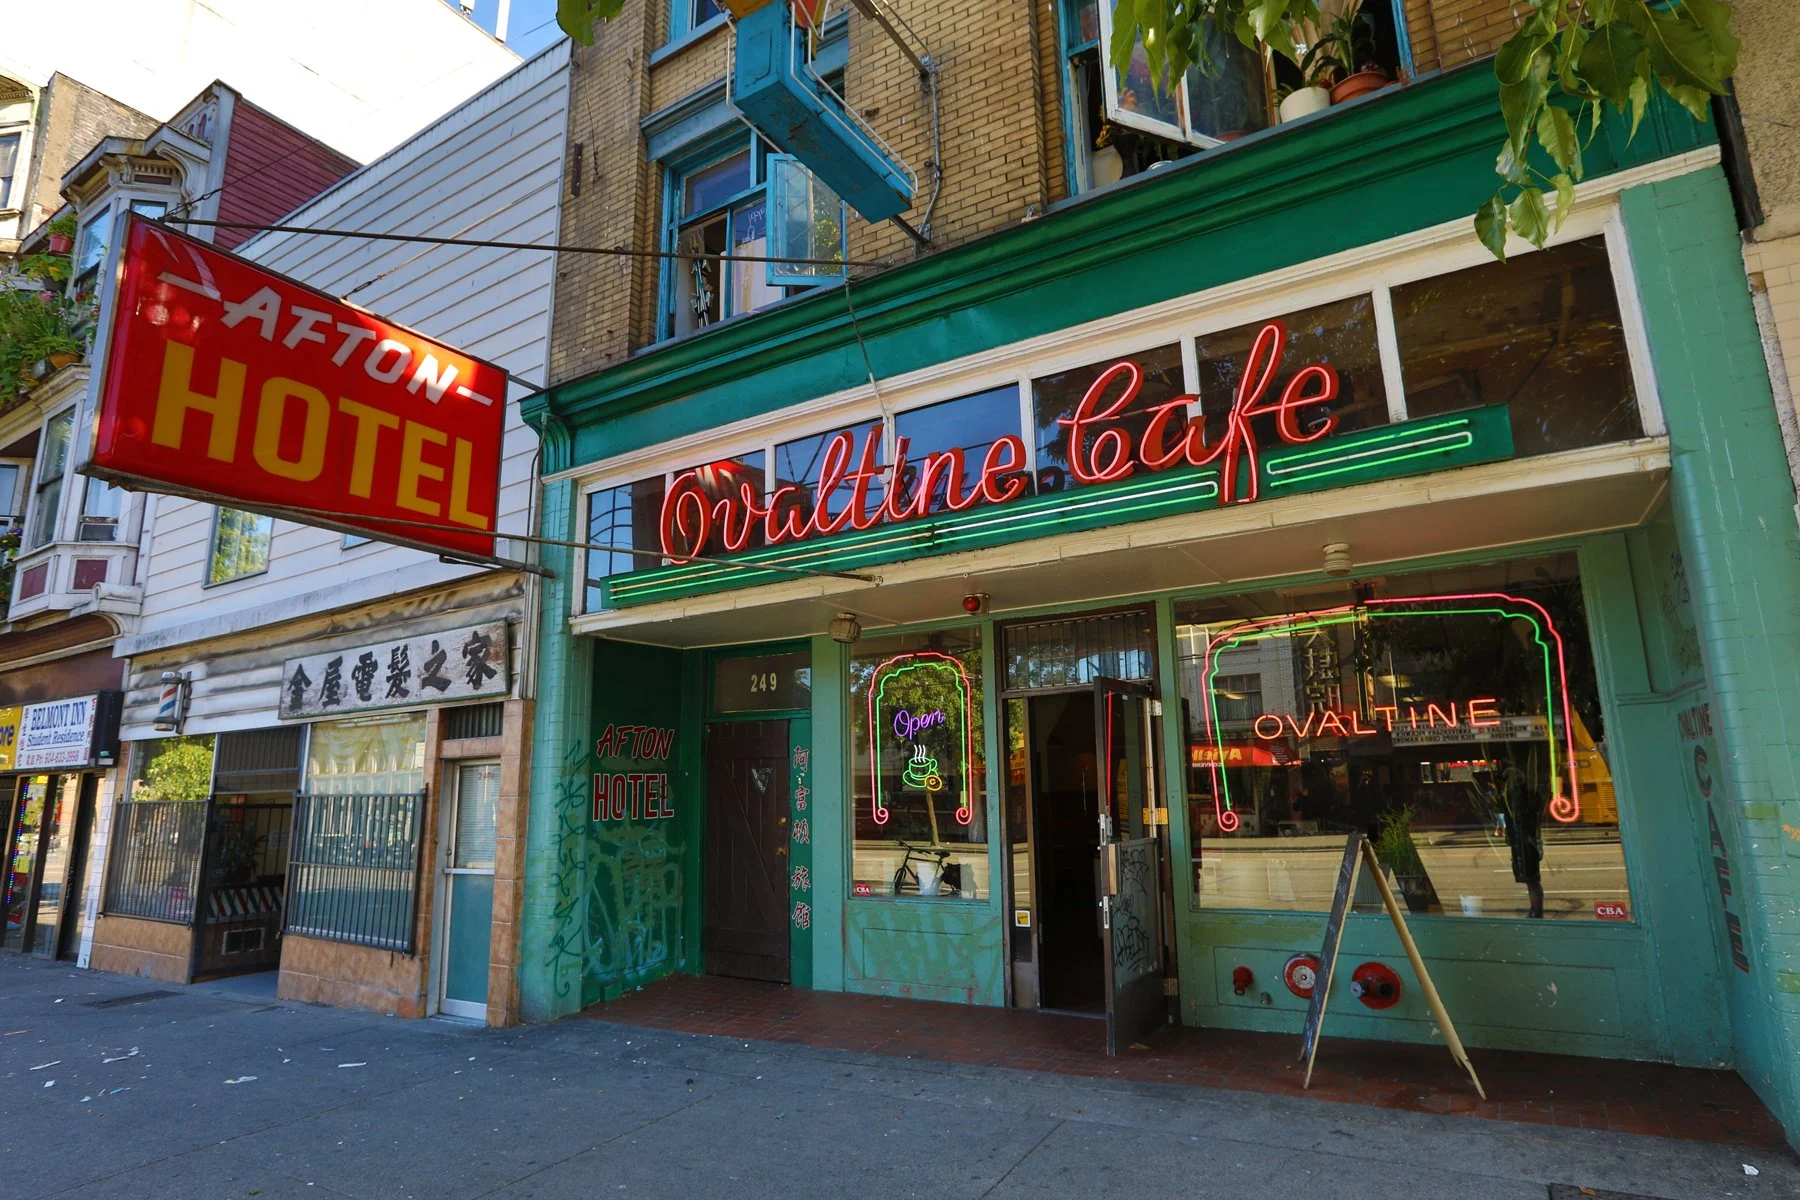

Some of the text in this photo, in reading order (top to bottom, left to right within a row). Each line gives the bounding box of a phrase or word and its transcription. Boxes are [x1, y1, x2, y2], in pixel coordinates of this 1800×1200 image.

[220, 285, 460, 405] AFTON
[151, 339, 489, 530] HOTEL
[659, 319, 1340, 565] Ovaltine Cafe
[750, 672, 778, 693] 249
[31, 700, 88, 731] BELMONT INN
[893, 709, 946, 741] Open
[1254, 698, 1501, 740] OVALTINE
[26, 728, 85, 748] Student Residence
[596, 723, 676, 760] AFTON
[592, 773, 675, 821] HOTEL
[1596, 906, 1625, 915] CBA
